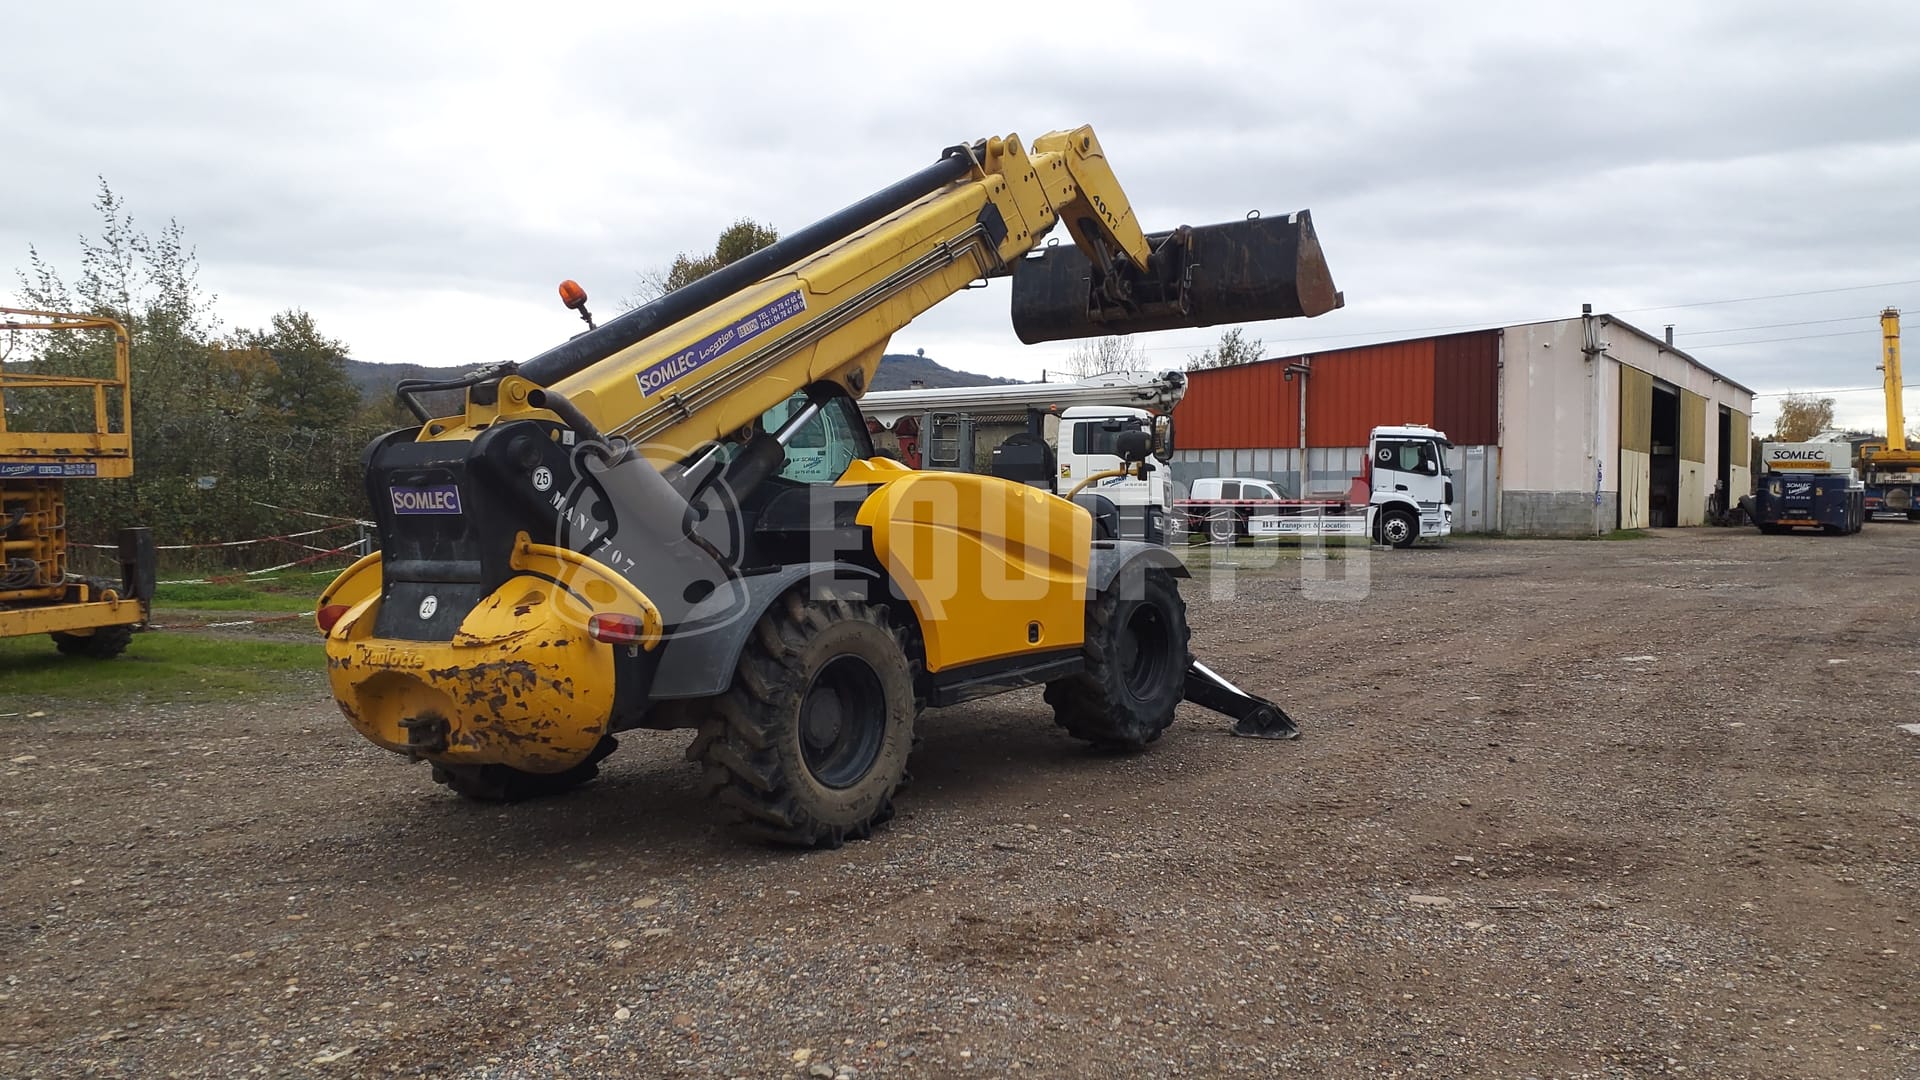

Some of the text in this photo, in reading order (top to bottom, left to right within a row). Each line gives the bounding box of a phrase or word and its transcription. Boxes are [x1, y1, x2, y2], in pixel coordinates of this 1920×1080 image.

[640, 329, 734, 391] SOMLEC Location
[1773, 450, 1824, 460] SOMLEC
[536, 472, 549, 486] 25
[394, 491, 456, 509] SOMLEC
[1277, 520, 1311, 531] Transport
[1321, 520, 1351, 529] Location
